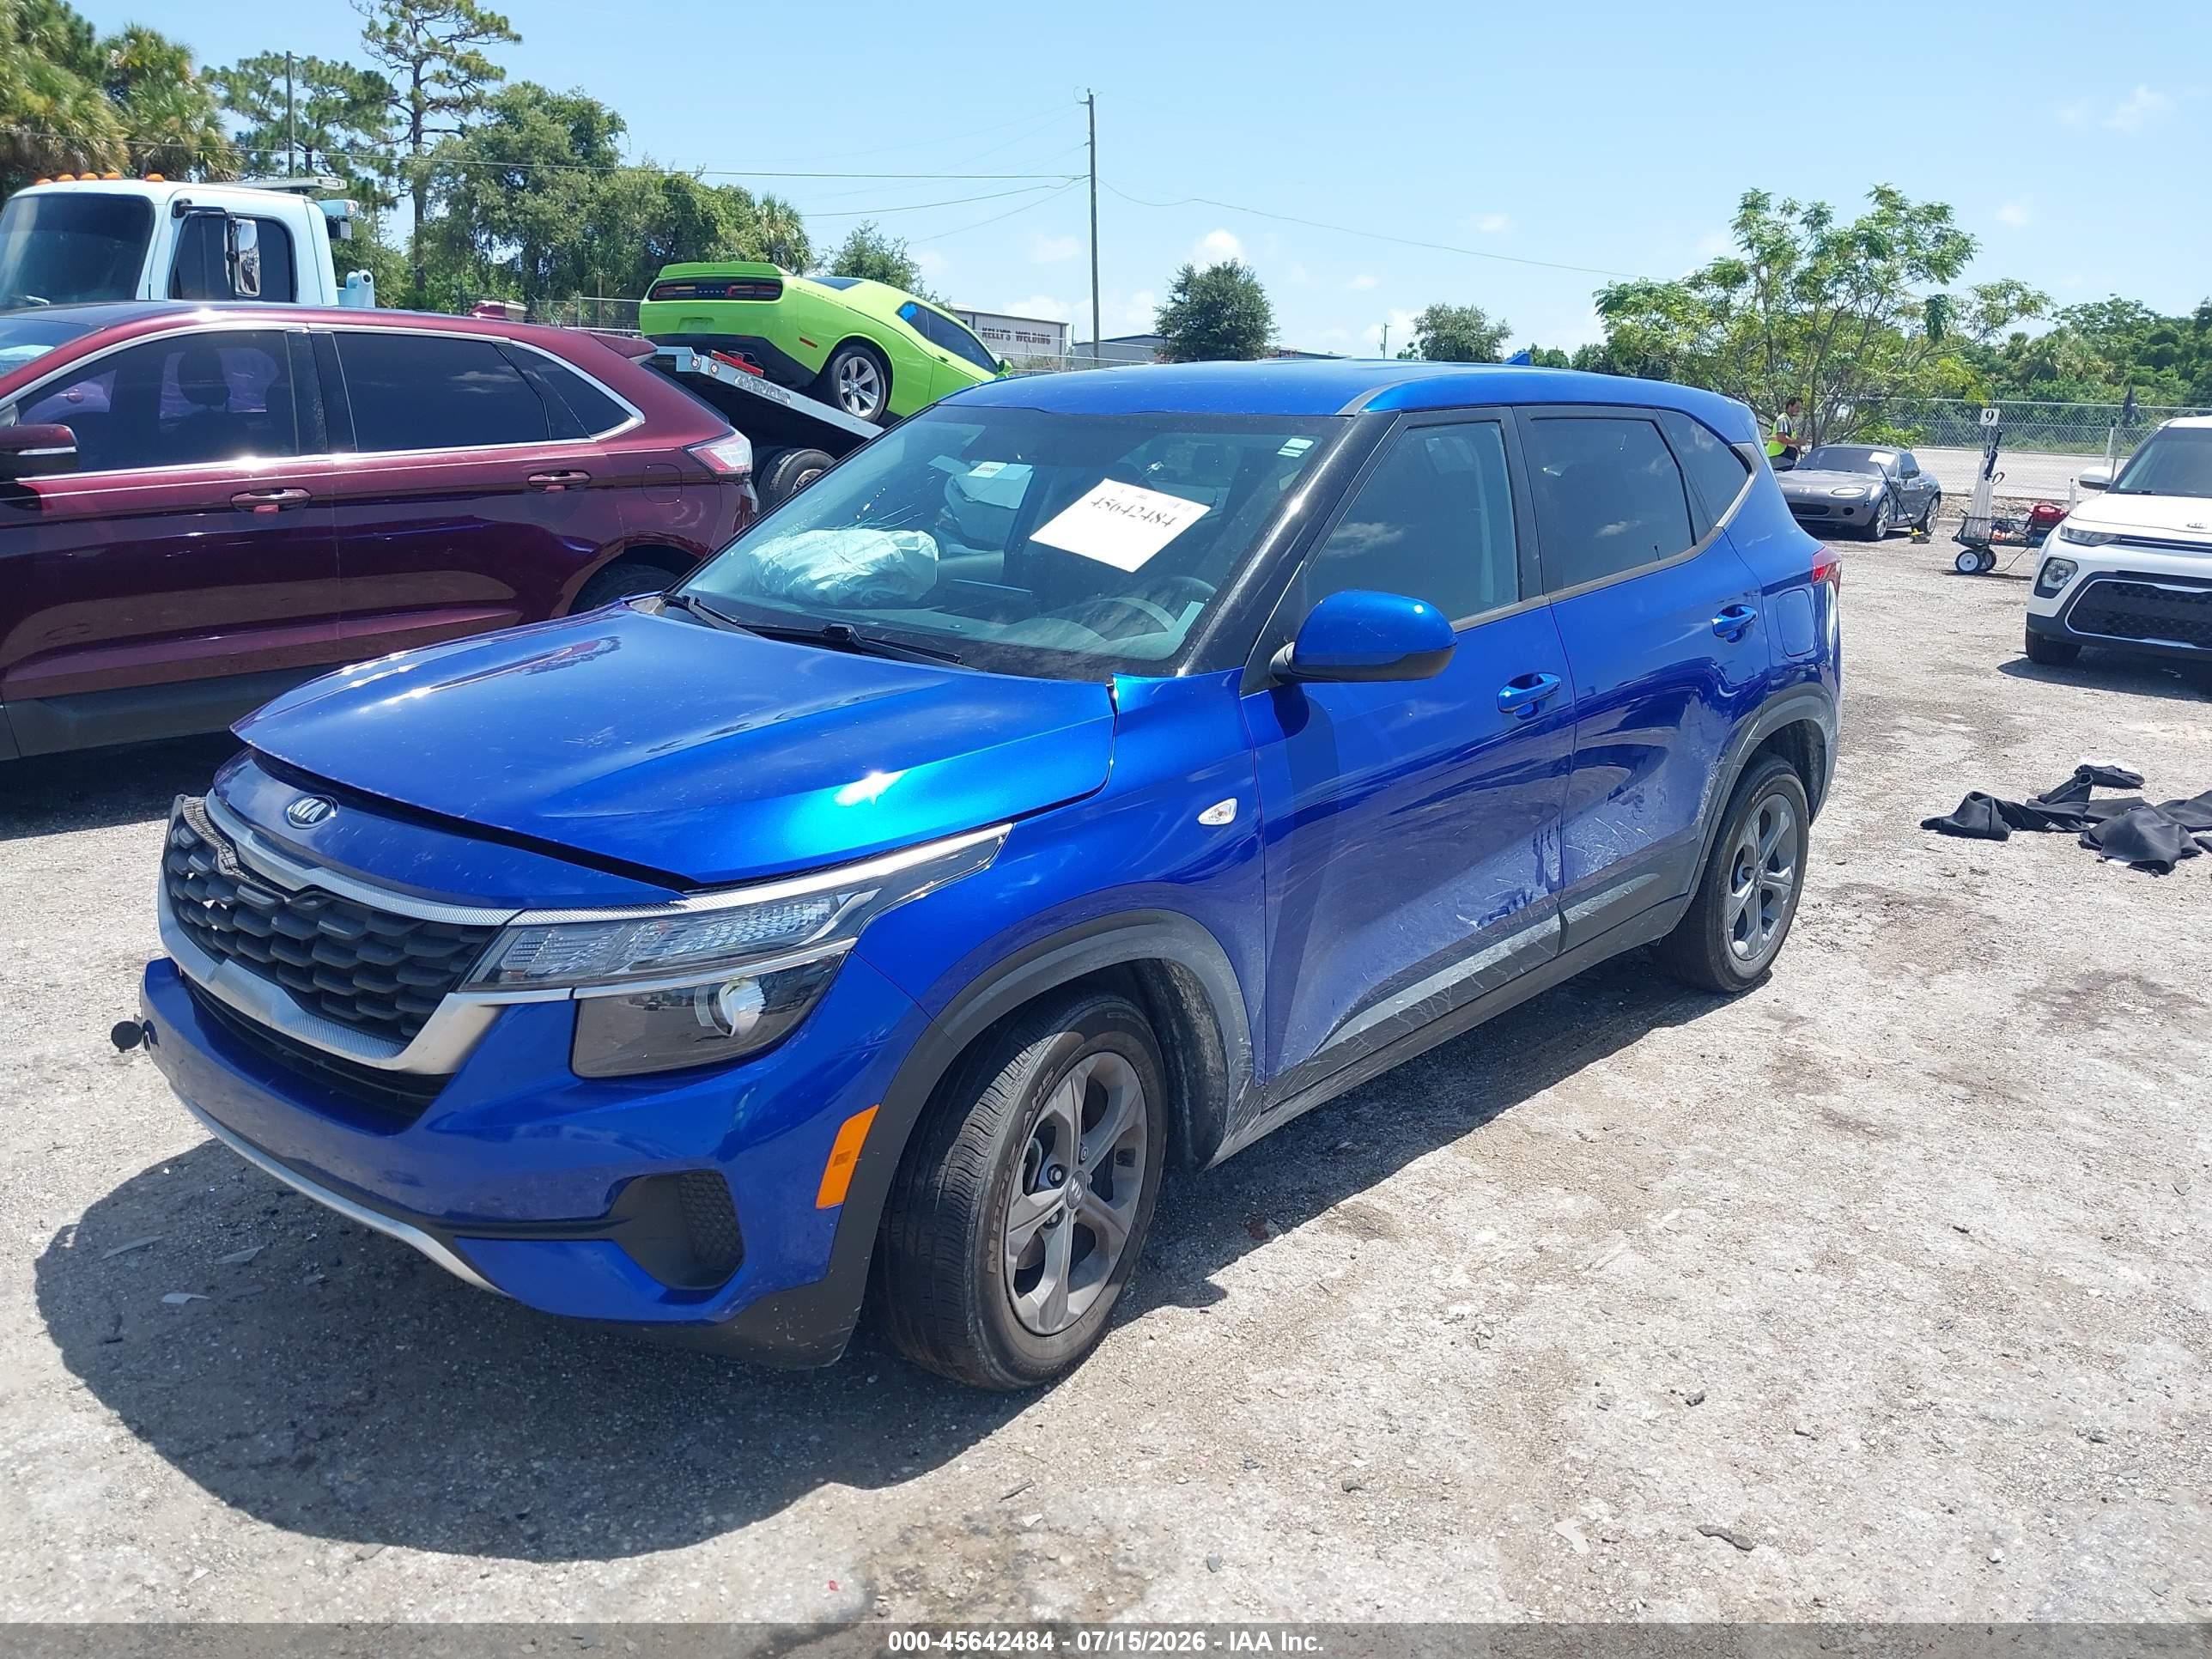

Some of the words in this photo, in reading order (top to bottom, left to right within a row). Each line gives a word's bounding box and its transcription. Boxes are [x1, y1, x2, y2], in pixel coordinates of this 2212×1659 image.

[1016, 331, 1051, 344] WELDING
[1984, 410, 1995, 424] 9
[292, 798, 326, 823] KIA
